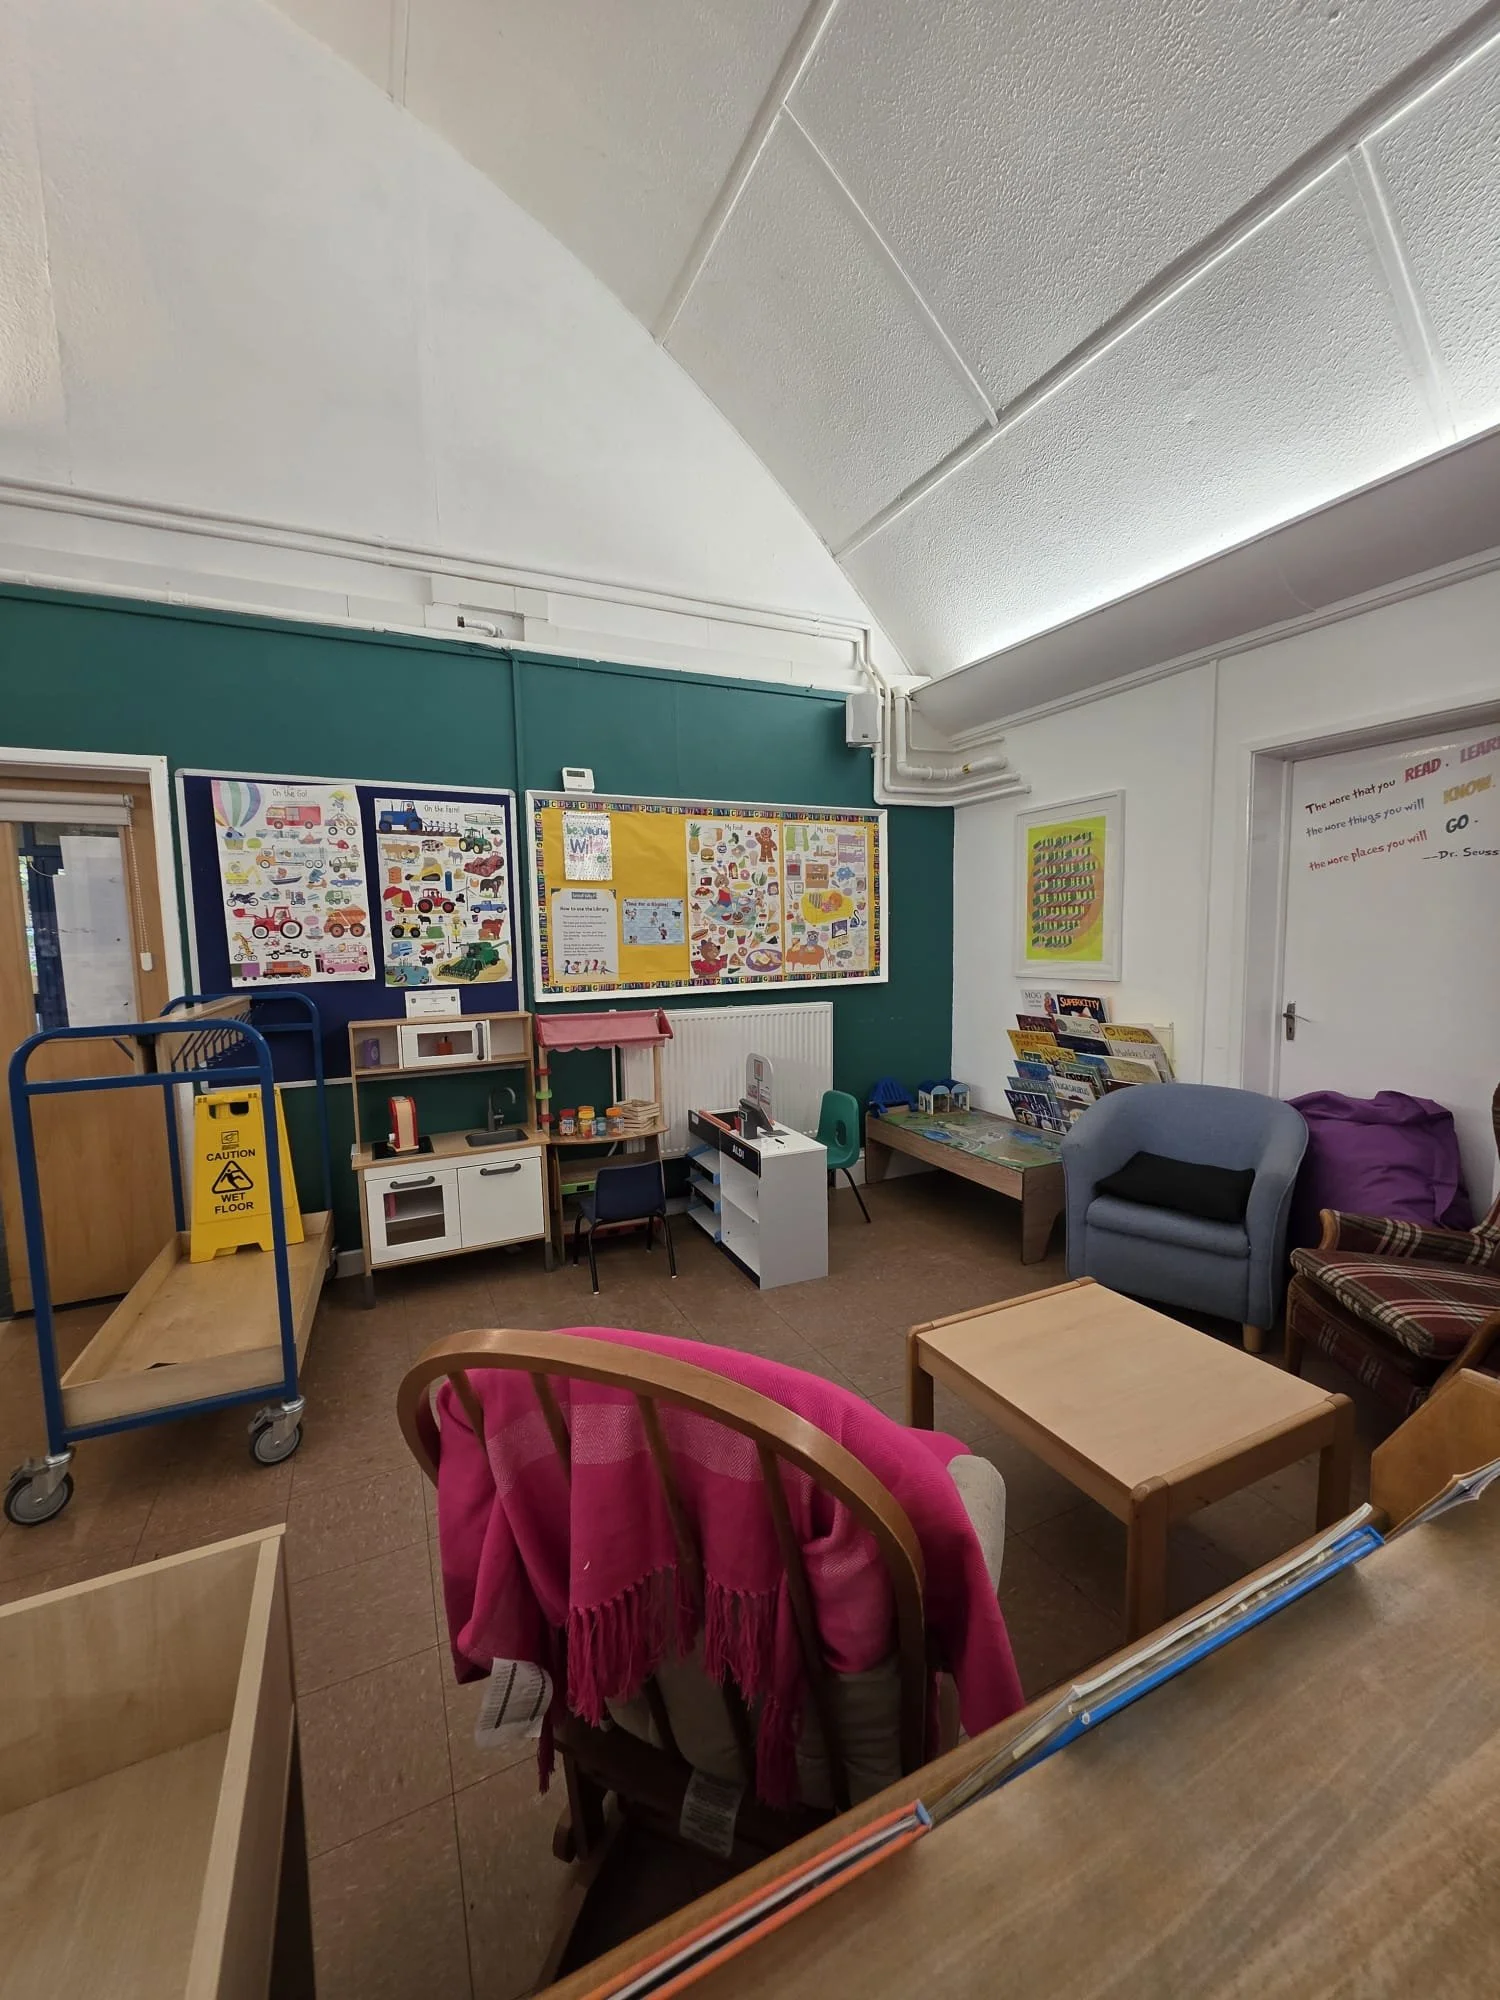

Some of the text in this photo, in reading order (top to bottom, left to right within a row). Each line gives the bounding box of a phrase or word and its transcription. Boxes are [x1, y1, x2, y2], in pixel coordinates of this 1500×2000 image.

[1305, 801, 1327, 815] The
[1329, 794, 1351, 807] more
[1352, 783, 1376, 799] that
[1378, 779, 1396, 795] you
[1306, 827, 1323, 838] the
[1325, 820, 1346, 832] more
[1348, 812, 1382, 826] things
[1384, 806, 1403, 820] you
[1405, 798, 1425, 812] will
[1310, 861, 1326, 871] the
[1328, 855, 1349, 867] more
[1351, 845, 1385, 862] places
[1387, 839, 1406, 853] you
[1407, 829, 1428, 845] will
[1463, 848, 1500, 857] Seuss
[206, 1149, 256, 1162] CAUTION
[733, 1144, 745, 1160] ALDI
[221, 1192, 246, 1203] WET
[215, 1202, 254, 1214] FLOOR
